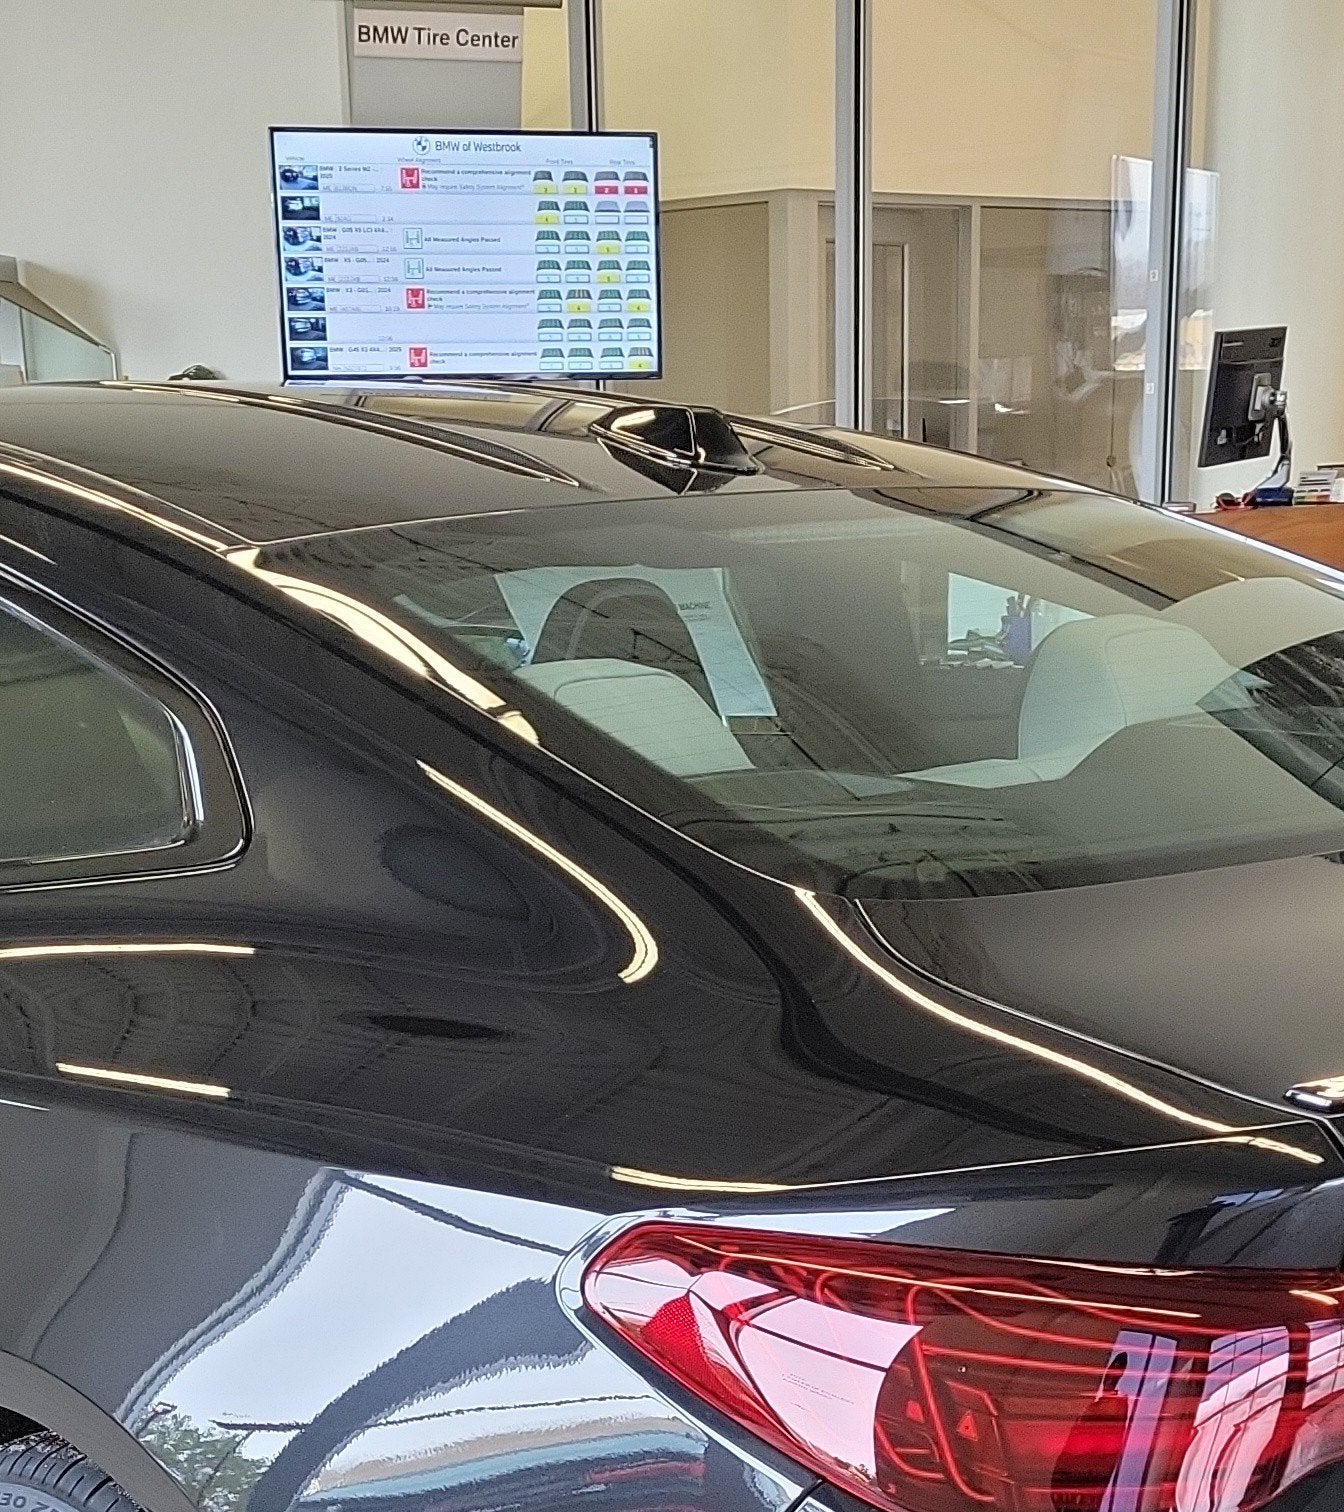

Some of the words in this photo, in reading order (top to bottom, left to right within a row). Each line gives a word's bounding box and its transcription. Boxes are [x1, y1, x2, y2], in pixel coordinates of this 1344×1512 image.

[358, 25, 408, 44] BMW
[413, 27, 450, 46] Tire
[456, 29, 518, 48] Center
[436, 141, 460, 152] BMW
[462, 141, 472, 152] of
[474, 141, 522, 152] Westbrook
[504, 169, 532, 177] alignment
